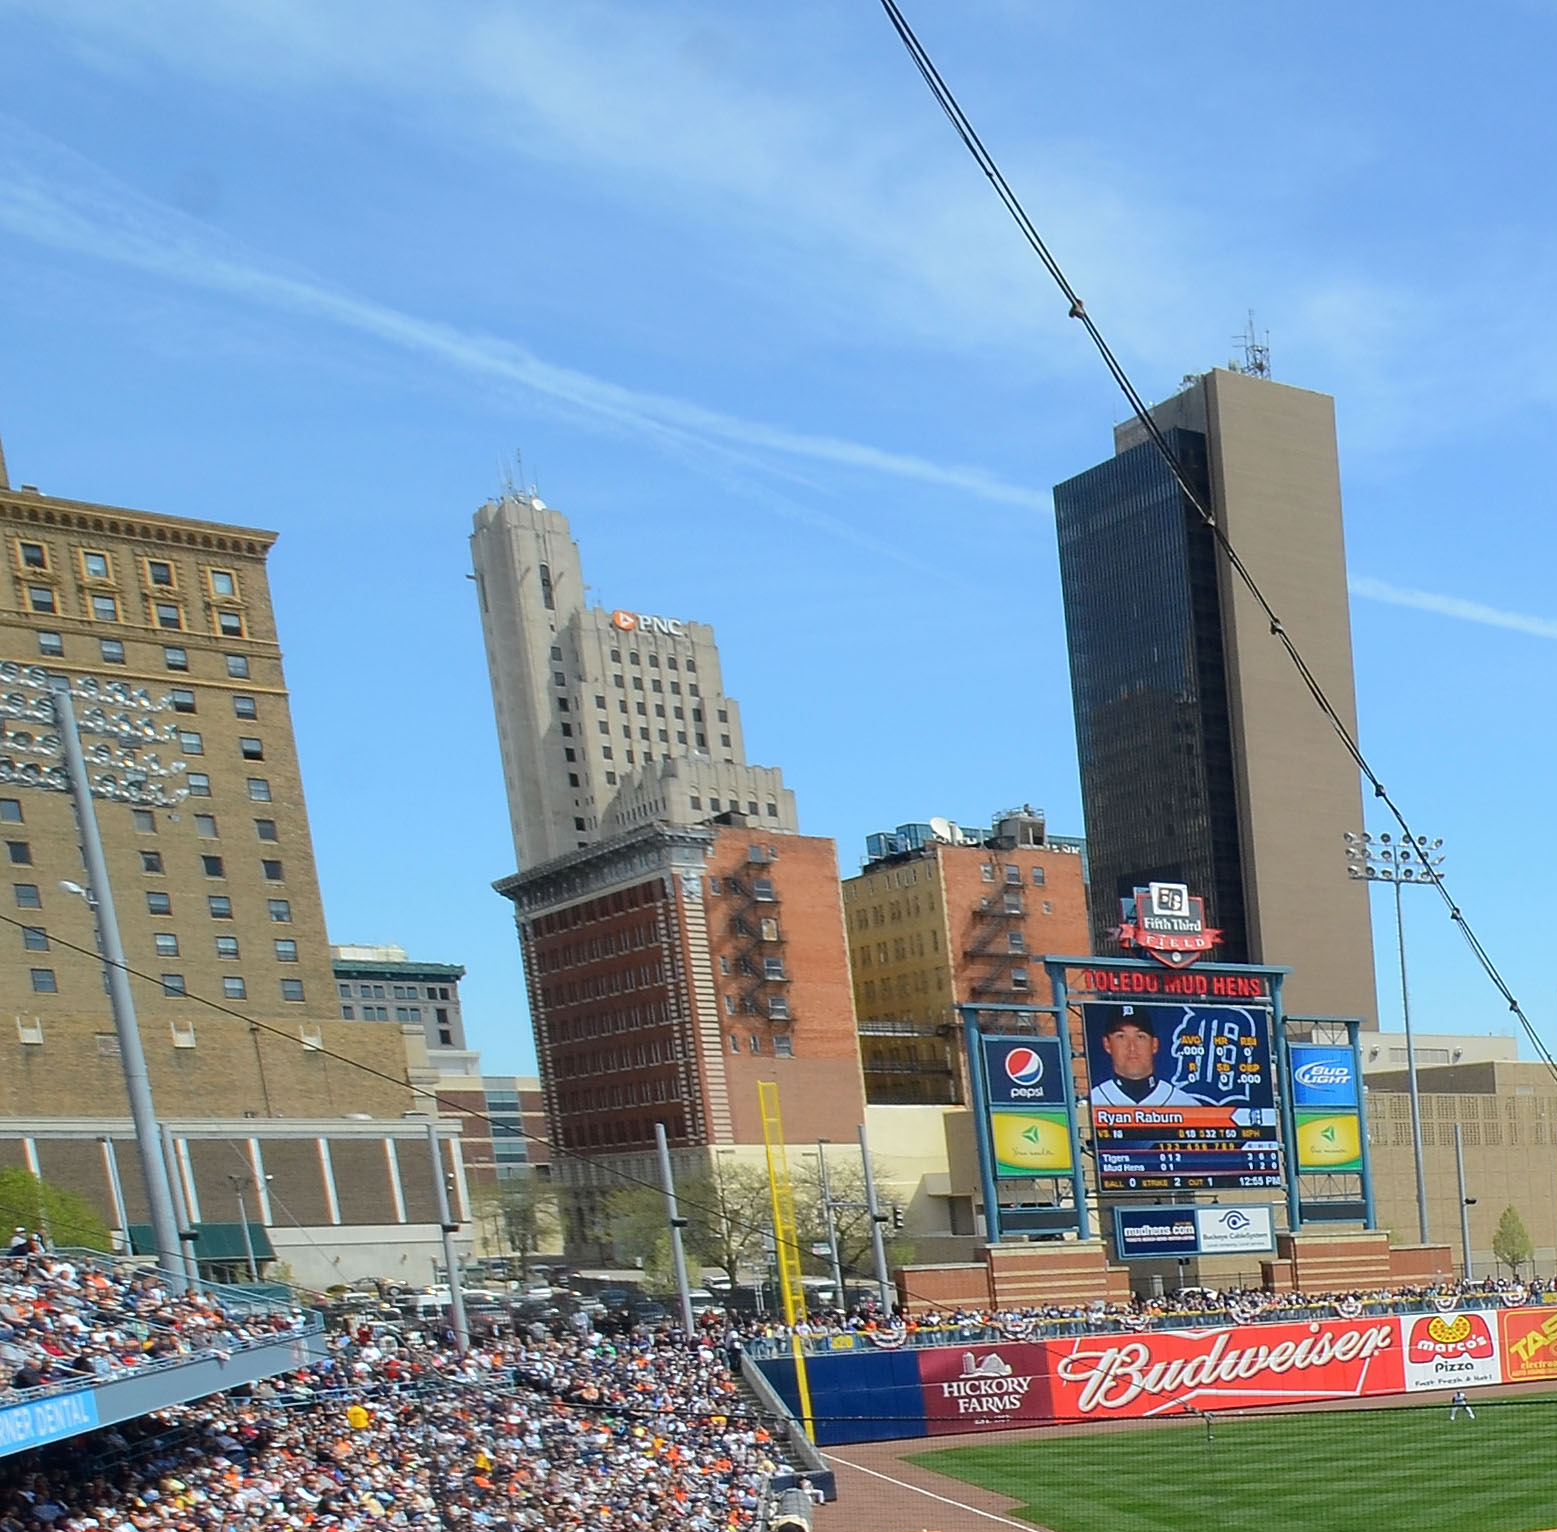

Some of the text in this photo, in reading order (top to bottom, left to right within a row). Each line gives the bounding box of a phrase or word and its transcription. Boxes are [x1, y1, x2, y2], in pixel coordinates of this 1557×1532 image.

[636, 614, 681, 636] PNC
[1144, 917, 1201, 931] Fifth Third
[1147, 936, 1205, 947] FIELD
[1085, 971, 1261, 996] TOLEDO MUD HENS
[1214, 1037, 1227, 1045] HR
[1180, 1047, 1251, 1056] .000 0 0
[1217, 1063, 1230, 1071] SB
[1188, 1074, 1260, 1083] 0 0 .000
[1303, 1075, 1352, 1084] LIGHT
[1011, 1087, 1044, 1098] pepsi
[1098, 1111, 1182, 1124] Ryan Raburn
[1206, 1130, 1217, 1138] 32
[1102, 1154, 1129, 1162] Tigers
[1129, 1178, 1136, 1186] 0
[1174, 1178, 1181, 1186] 2
[1266, 1176, 1280, 1185] PM
[1124, 1225, 1194, 1236] mudhens.com
[1417, 1334, 1487, 1352] marco's
[1058, 1323, 1392, 1412] Budweiser
[942, 1377, 1032, 1397] HICKORY
[958, 1395, 1022, 1413] FARMS
[35, 1396, 89, 1436] DENTAL
